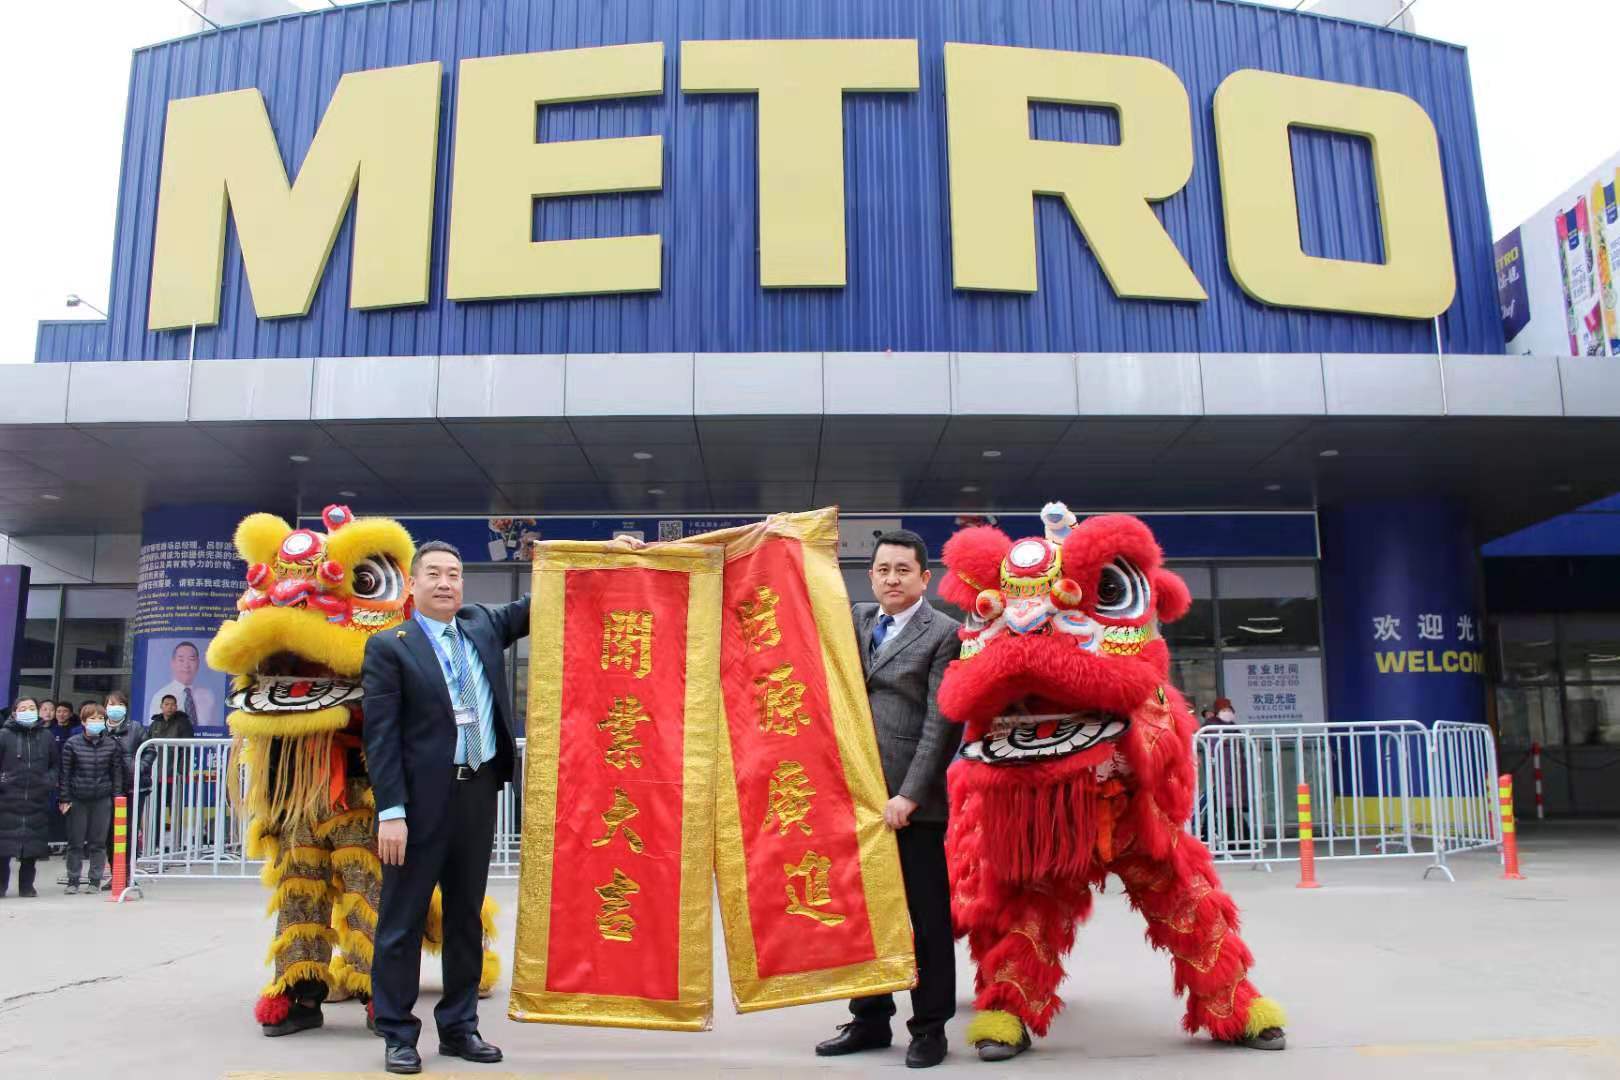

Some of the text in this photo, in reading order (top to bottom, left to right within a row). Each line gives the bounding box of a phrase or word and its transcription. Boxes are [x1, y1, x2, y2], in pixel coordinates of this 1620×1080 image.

[148, 38, 1457, 331] METRO
[1247, 664, 1299, 676] 营业时间
[1252, 692, 1297, 705] 欢迎光临
